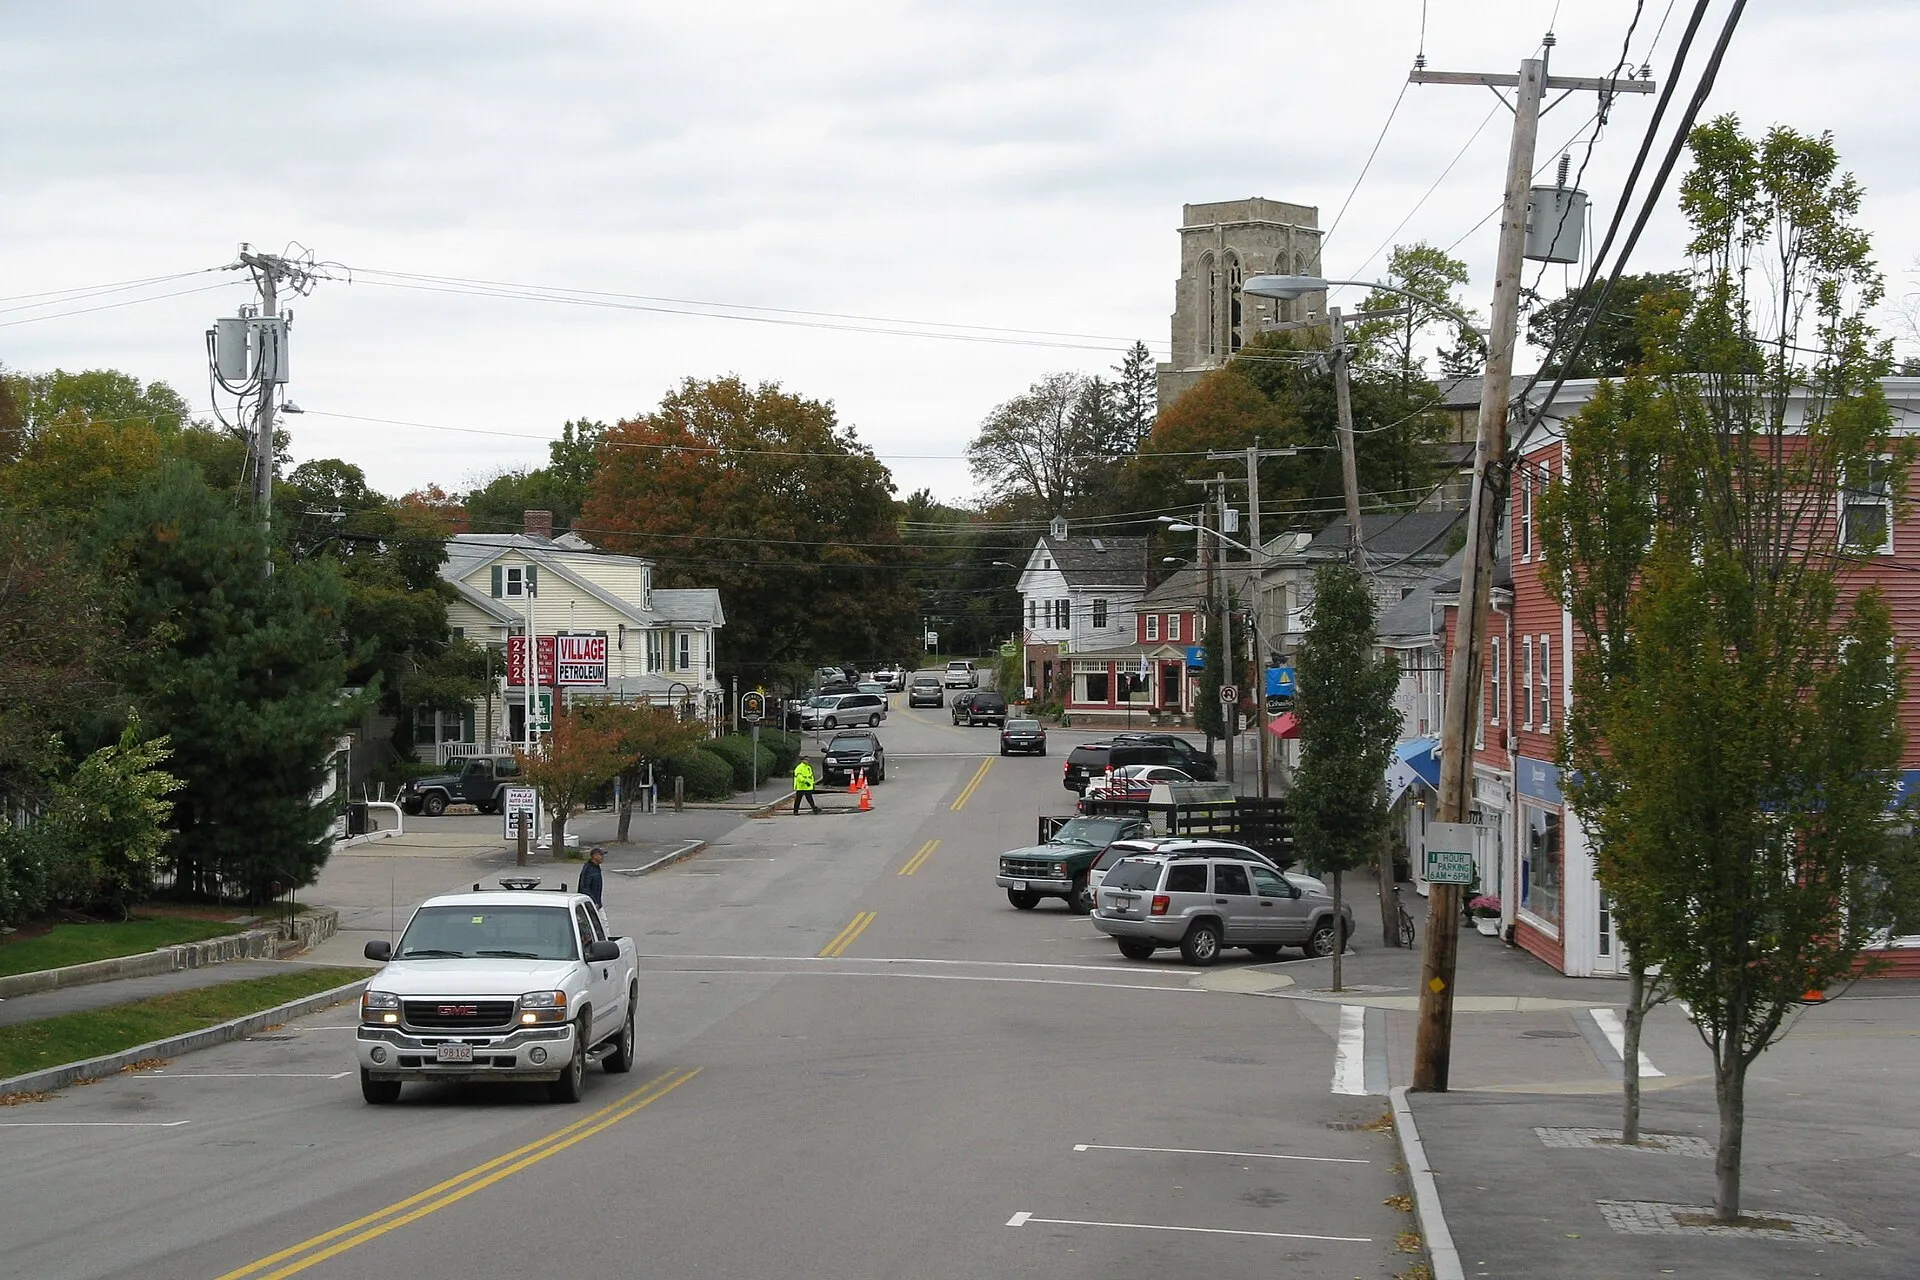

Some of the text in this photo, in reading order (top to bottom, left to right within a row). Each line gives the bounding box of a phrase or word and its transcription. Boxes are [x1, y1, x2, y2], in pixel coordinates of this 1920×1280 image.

[560, 638, 604, 660] VILLAGE
[560, 665, 604, 679] PETROLEUM
[1442, 854, 1464, 862] HOUR
[1437, 862, 1469, 872] PARKING
[437, 1005, 477, 1016] GMC
